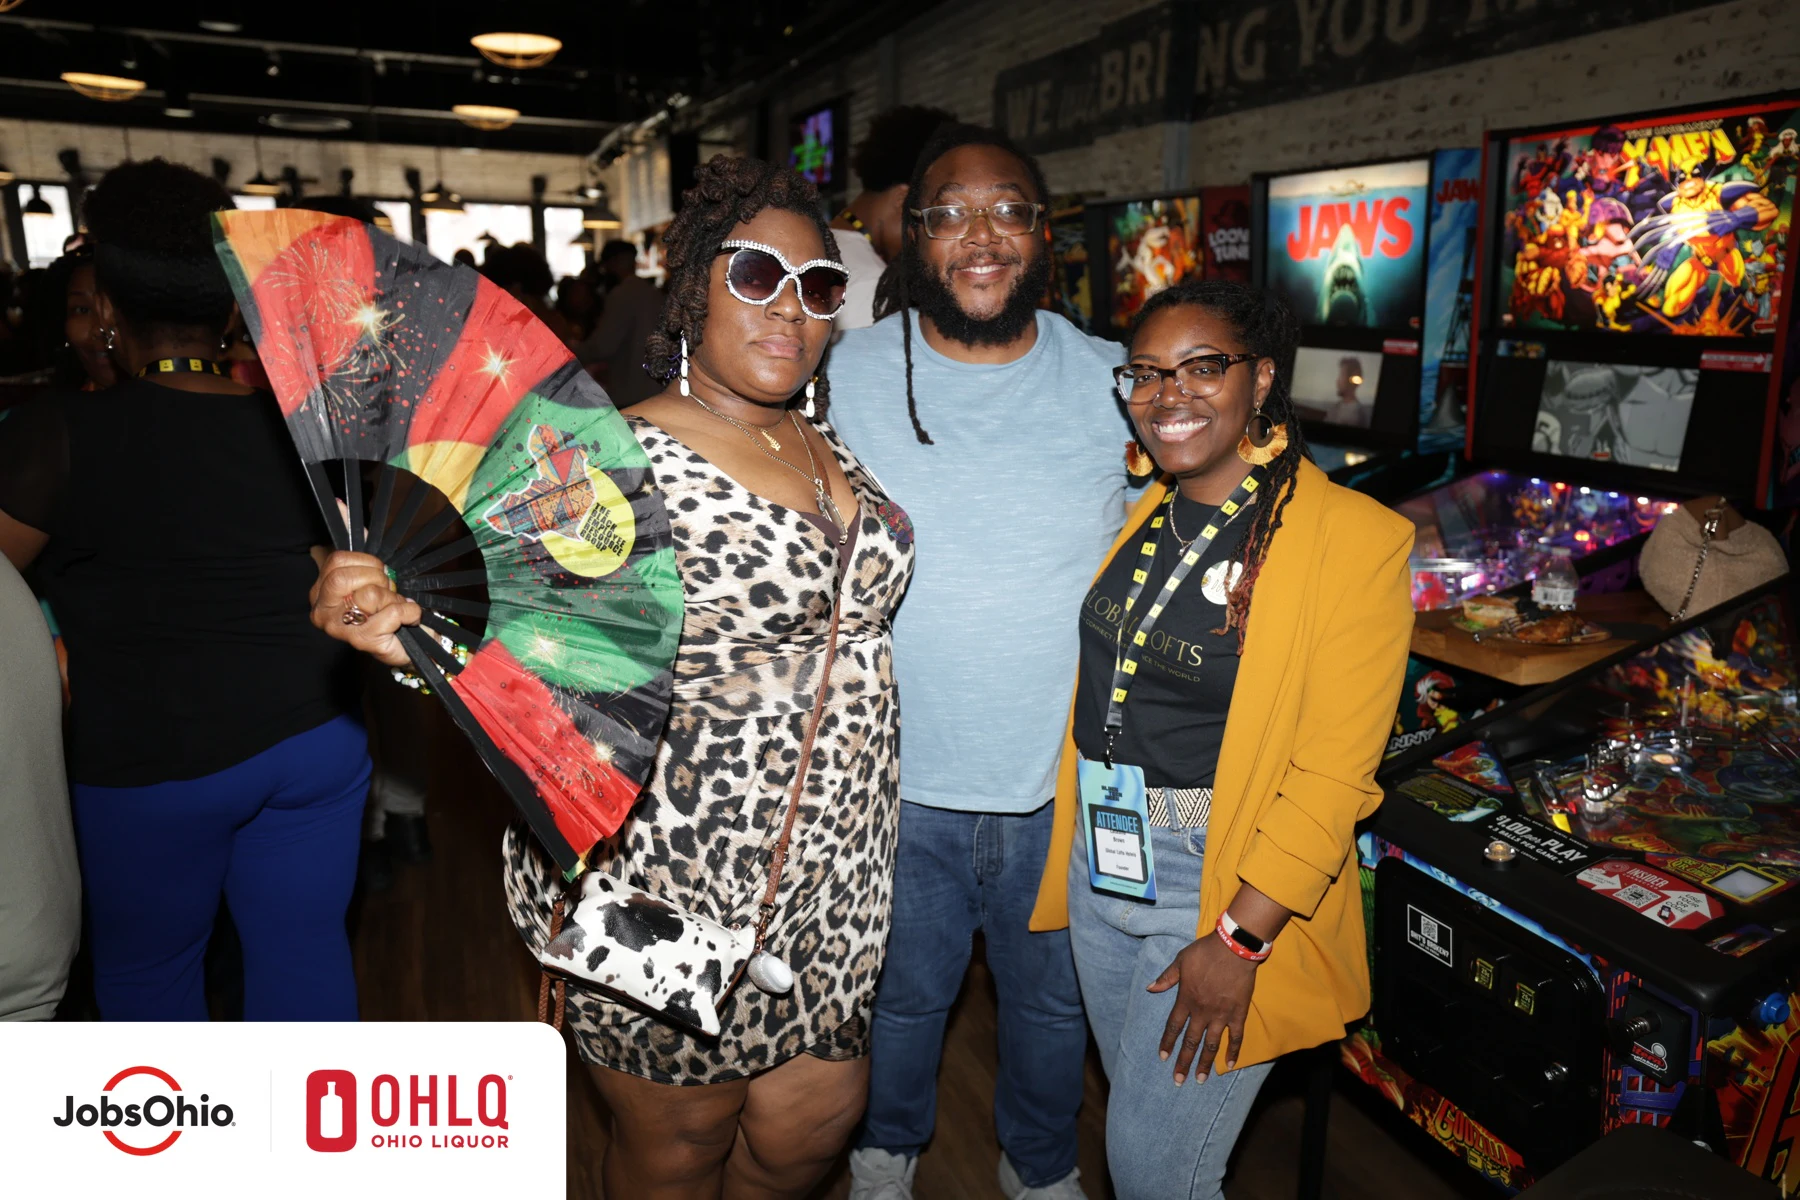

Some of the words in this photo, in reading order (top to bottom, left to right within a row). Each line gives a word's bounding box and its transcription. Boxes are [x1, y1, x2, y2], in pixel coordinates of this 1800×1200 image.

[1006, 80, 1054, 140] WE
[1436, 178, 1480, 205] JAW
[1207, 227, 1250, 247] LOON
[1287, 196, 1414, 263] JAWS
[591, 509, 618, 532] BLACK
[594, 502, 611, 518] THE
[580, 529, 607, 552] GROUP
[583, 522, 624, 557] RESOURCE
[587, 515, 626, 548] EMPLOYEE
[1144, 630, 1203, 667] OFTS
[1167, 666, 1201, 682] WORLD
[1096, 811, 1139, 834] ATTENDEE
[1495, 814, 1532, 838] $1.00
[1540, 838, 1588, 862] PLAY
[1498, 830, 1521, 843] BALLS
[1520, 840, 1536, 850] PER
[1535, 848, 1558, 862] GAME
[1627, 868, 1670, 888] INSIDER
[1665, 901, 1688, 914] CODE
[1677, 895, 1699, 908] YOUR
[1685, 894, 1703, 903] USE
